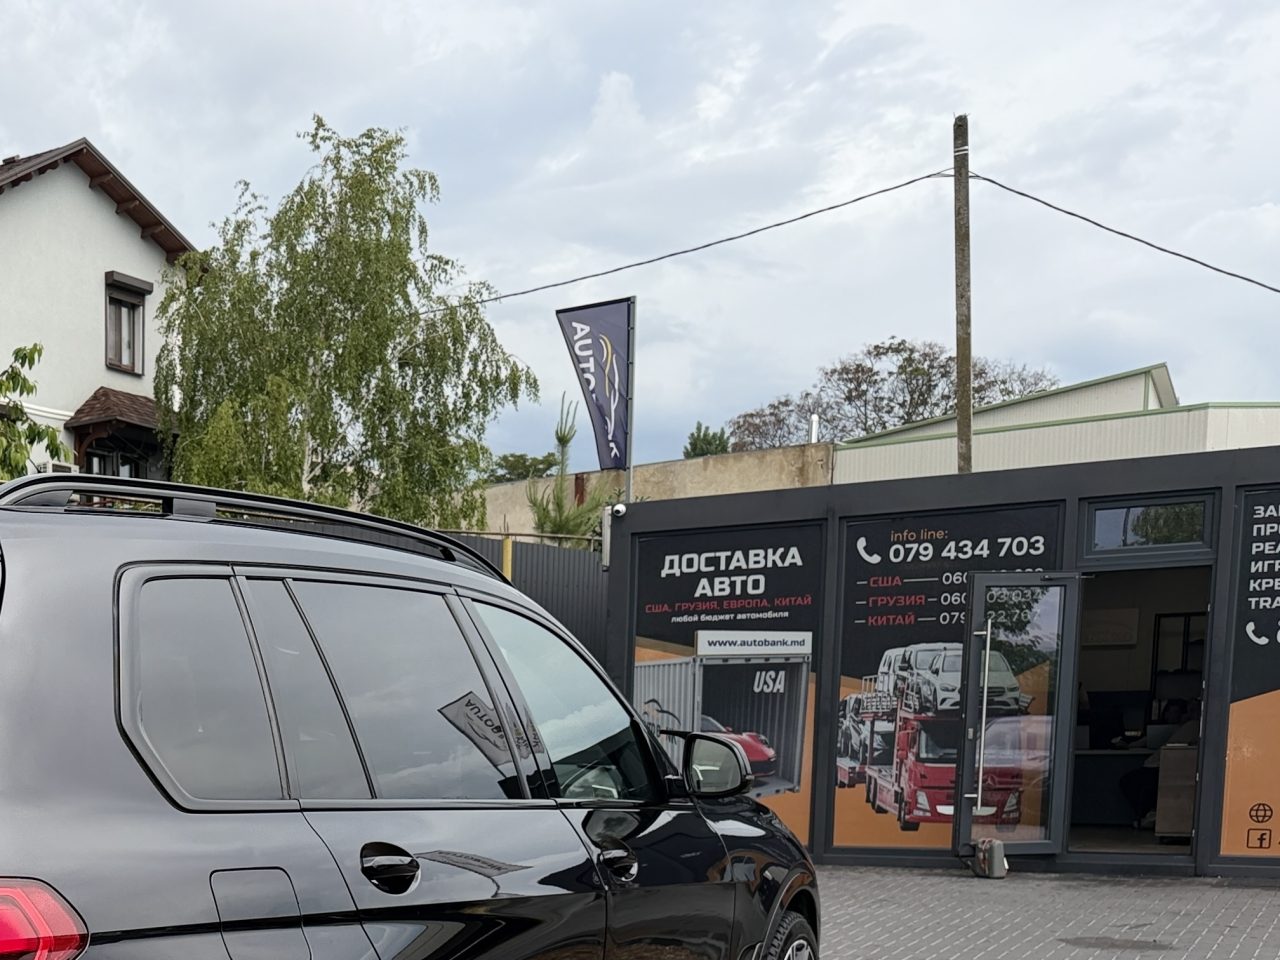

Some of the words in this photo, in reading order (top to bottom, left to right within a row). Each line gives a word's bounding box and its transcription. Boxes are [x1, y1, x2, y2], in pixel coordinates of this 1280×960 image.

[1253, 505, 1280, 519] ЗА
[890, 529, 917, 543] info
[920, 528, 949, 541] line:
[1252, 523, 1280, 537] ПР
[888, 542, 934, 563] 079
[941, 538, 990, 560] 434
[997, 535, 1045, 558] 703
[660, 546, 803, 578] ДОСТАВКА
[693, 574, 766, 598] АВТО
[869, 575, 902, 588] США
[774, 594, 813, 606] КИТАЙ
[868, 594, 926, 608] ГРУЗИЯ
[671, 613, 699, 624] любой
[700, 611, 735, 623] бюджет
[736, 609, 789, 621] автомобиля
[867, 612, 915, 626] КИТАЙ
[707, 638, 806, 648] www.autobank.md
[753, 669, 787, 694] USA
